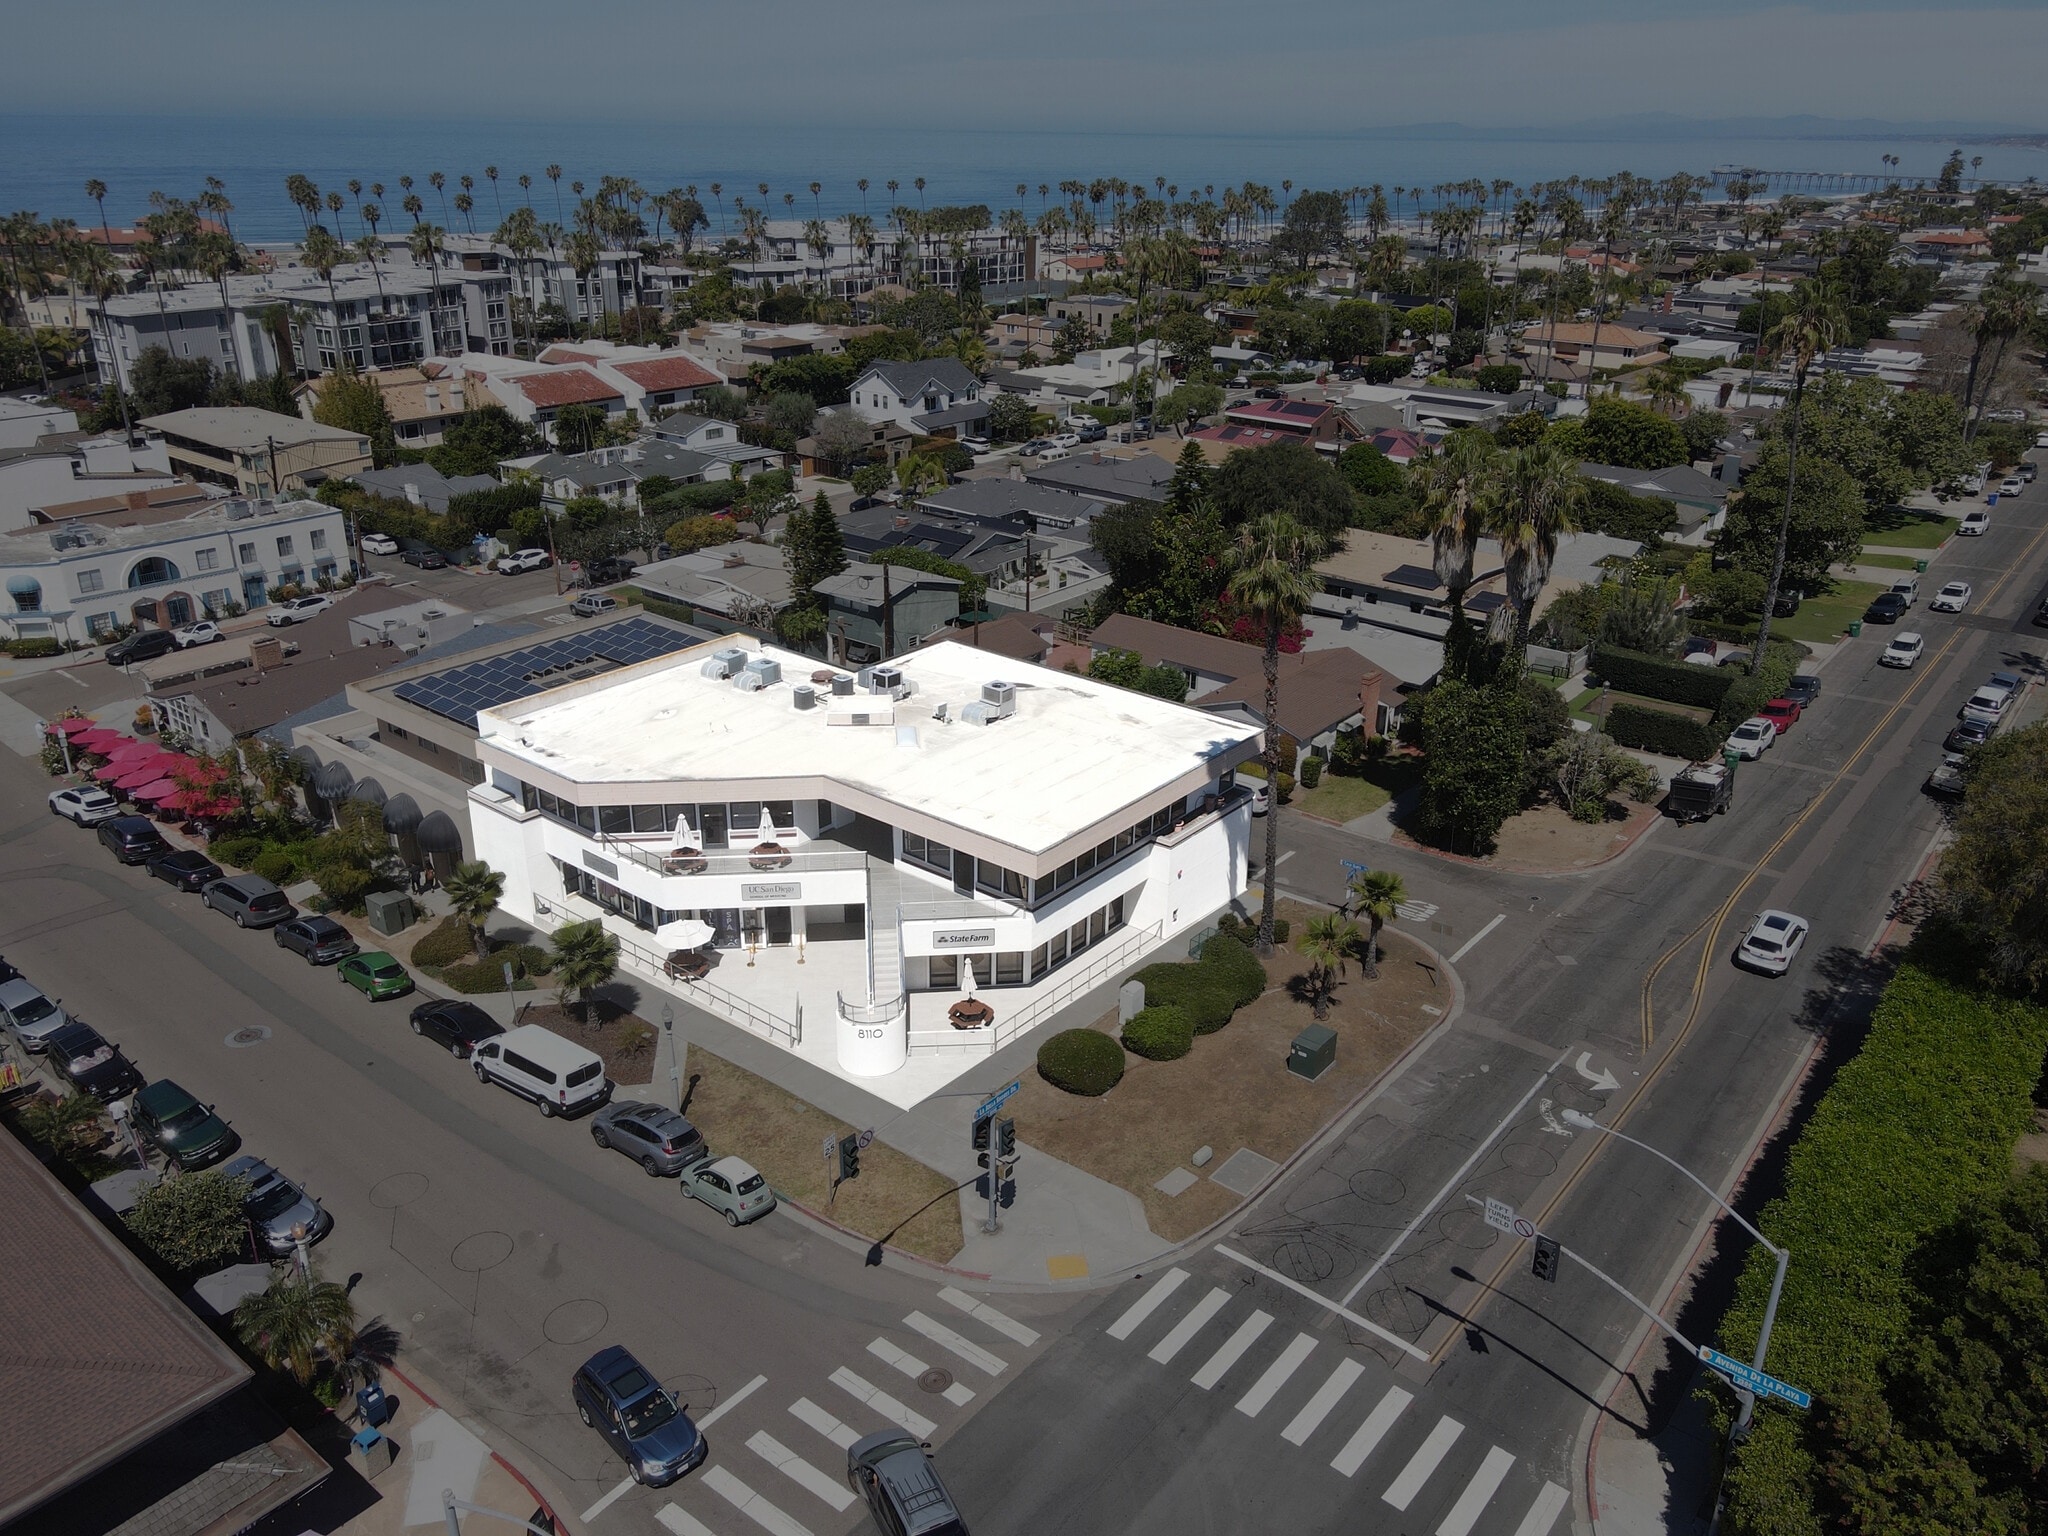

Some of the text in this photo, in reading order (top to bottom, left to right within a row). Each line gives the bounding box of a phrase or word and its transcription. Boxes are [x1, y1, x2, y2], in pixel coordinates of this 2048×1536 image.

[774, 885, 794, 894] Diego
[726, 911, 734, 931] SPA
[857, 1028, 884, 1039] 8110
[824, 1143, 835, 1157] 25
[1490, 1201, 1509, 1214] LEFT
[1487, 1208, 1511, 1223] TURNS
[1487, 1214, 1510, 1229] YIELD
[1714, 1355, 1801, 1402] AVENIDA DE LA PLAYA
